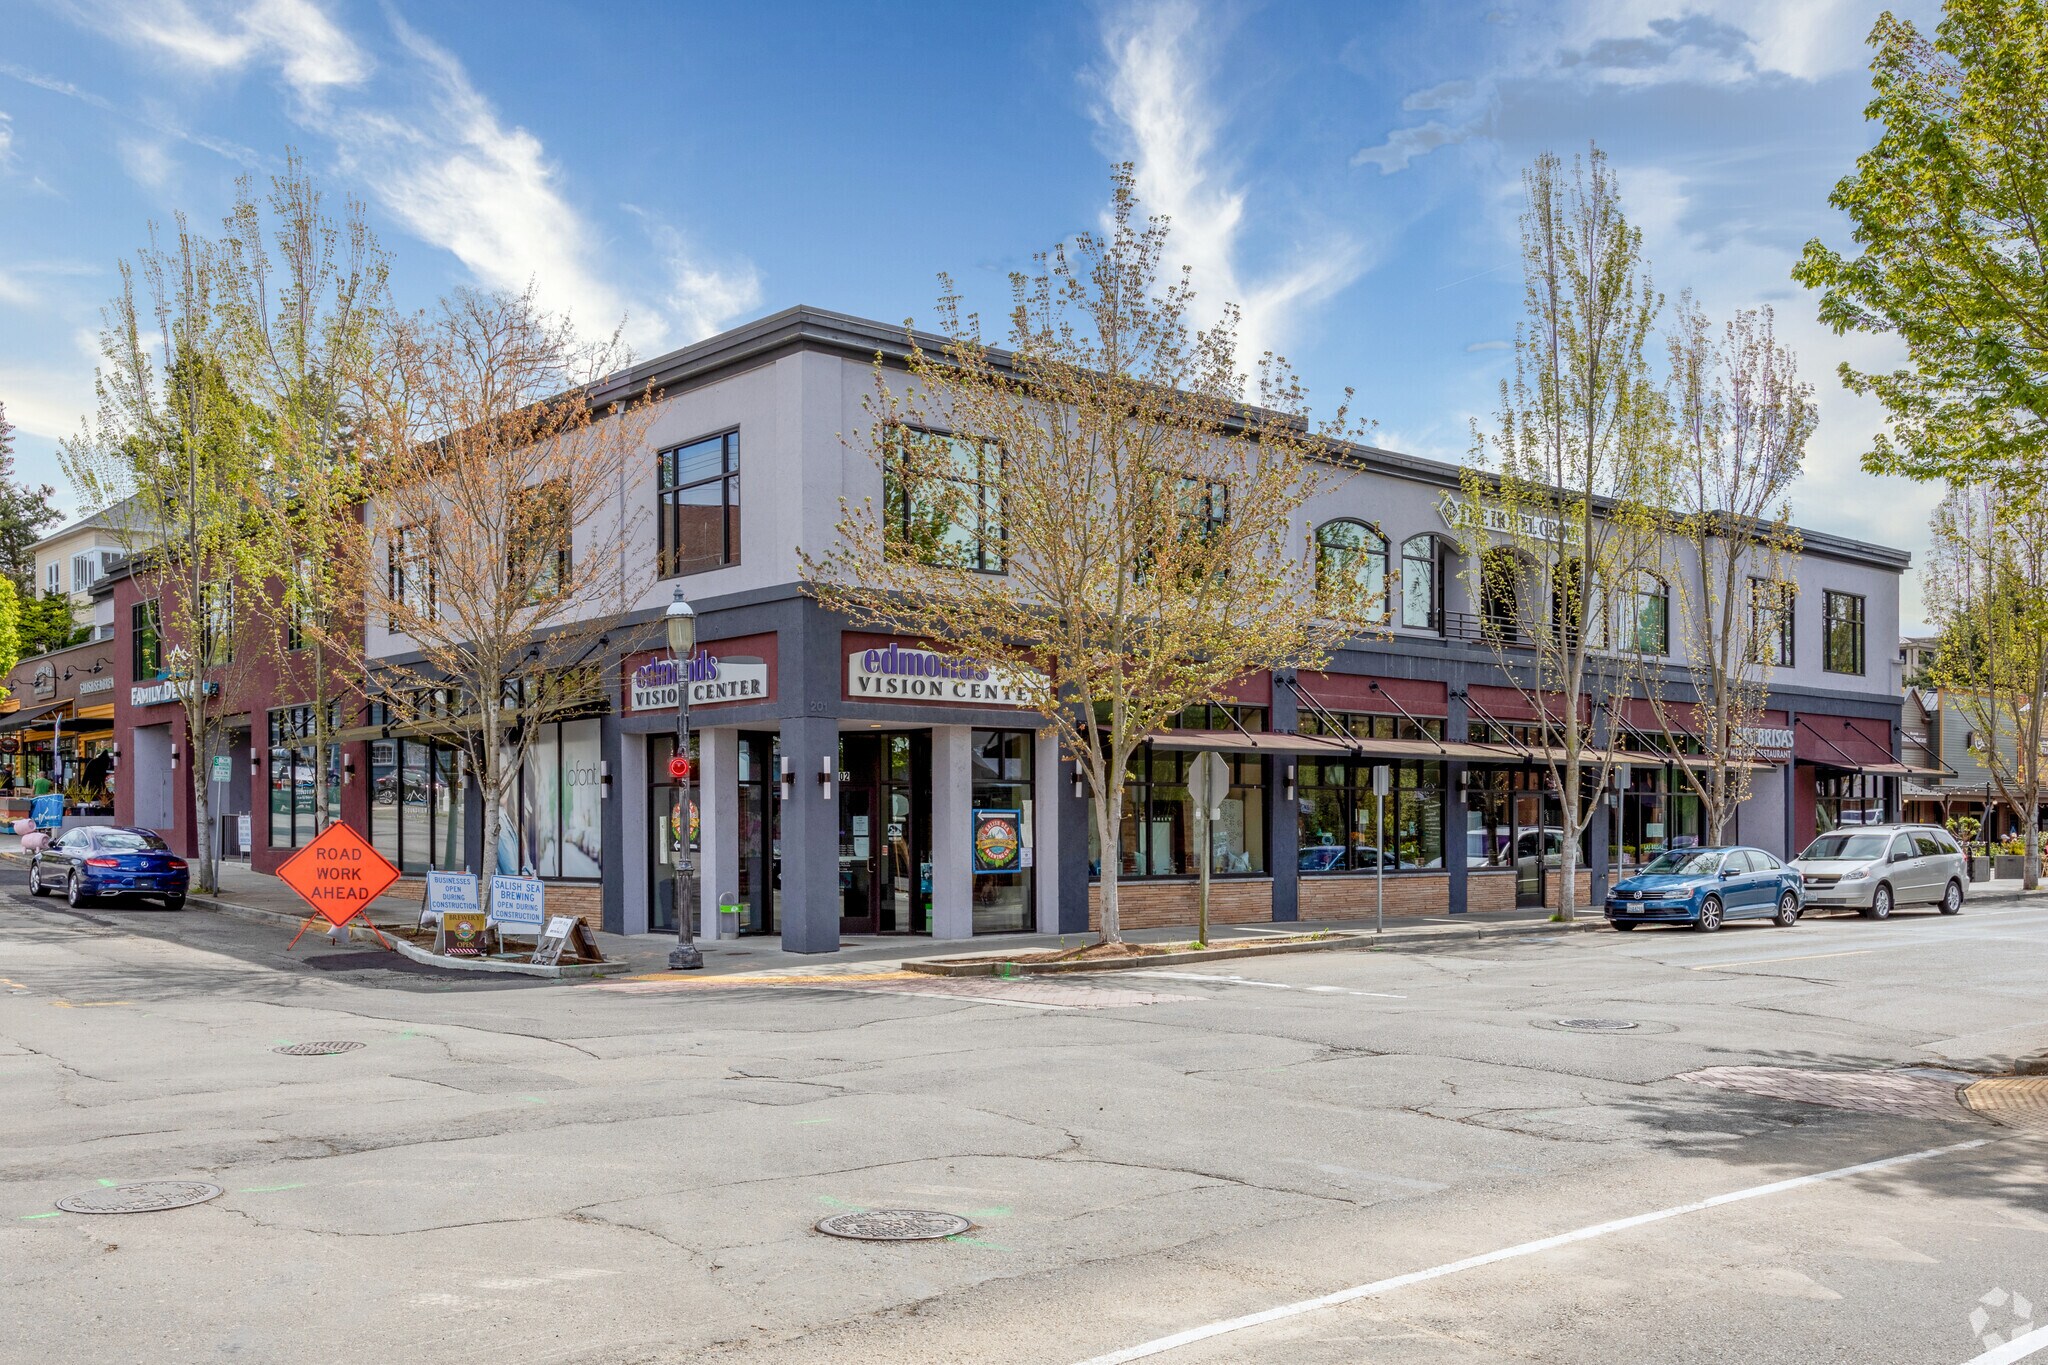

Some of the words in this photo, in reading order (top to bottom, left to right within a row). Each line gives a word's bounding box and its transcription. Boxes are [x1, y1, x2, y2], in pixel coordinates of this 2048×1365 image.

[131, 685, 163, 706] FAMILY
[635, 688, 678, 706] VISIO
[694, 679, 761, 700] CENTER
[858, 676, 943, 696] VISION
[952, 681, 1036, 704] CENTE
[810, 701, 829, 712] 201
[1757, 728, 1794, 748] BRISAS
[316, 848, 362, 860] ROAD
[316, 867, 362, 880] WORK
[434, 876, 471, 885] BUSINESSES
[495, 880, 522, 891] SALISH
[526, 883, 540, 893] SEA
[311, 886, 369, 900] AHEAD
[442, 893, 465, 901] DURING
[500, 890, 535, 902] BREWING
[432, 901, 477, 910] CONSTRUCTION
[497, 901, 514, 909] OPEN
[516, 903, 539, 912] DURING
[495, 910, 540, 920] CONSTRUCTION
